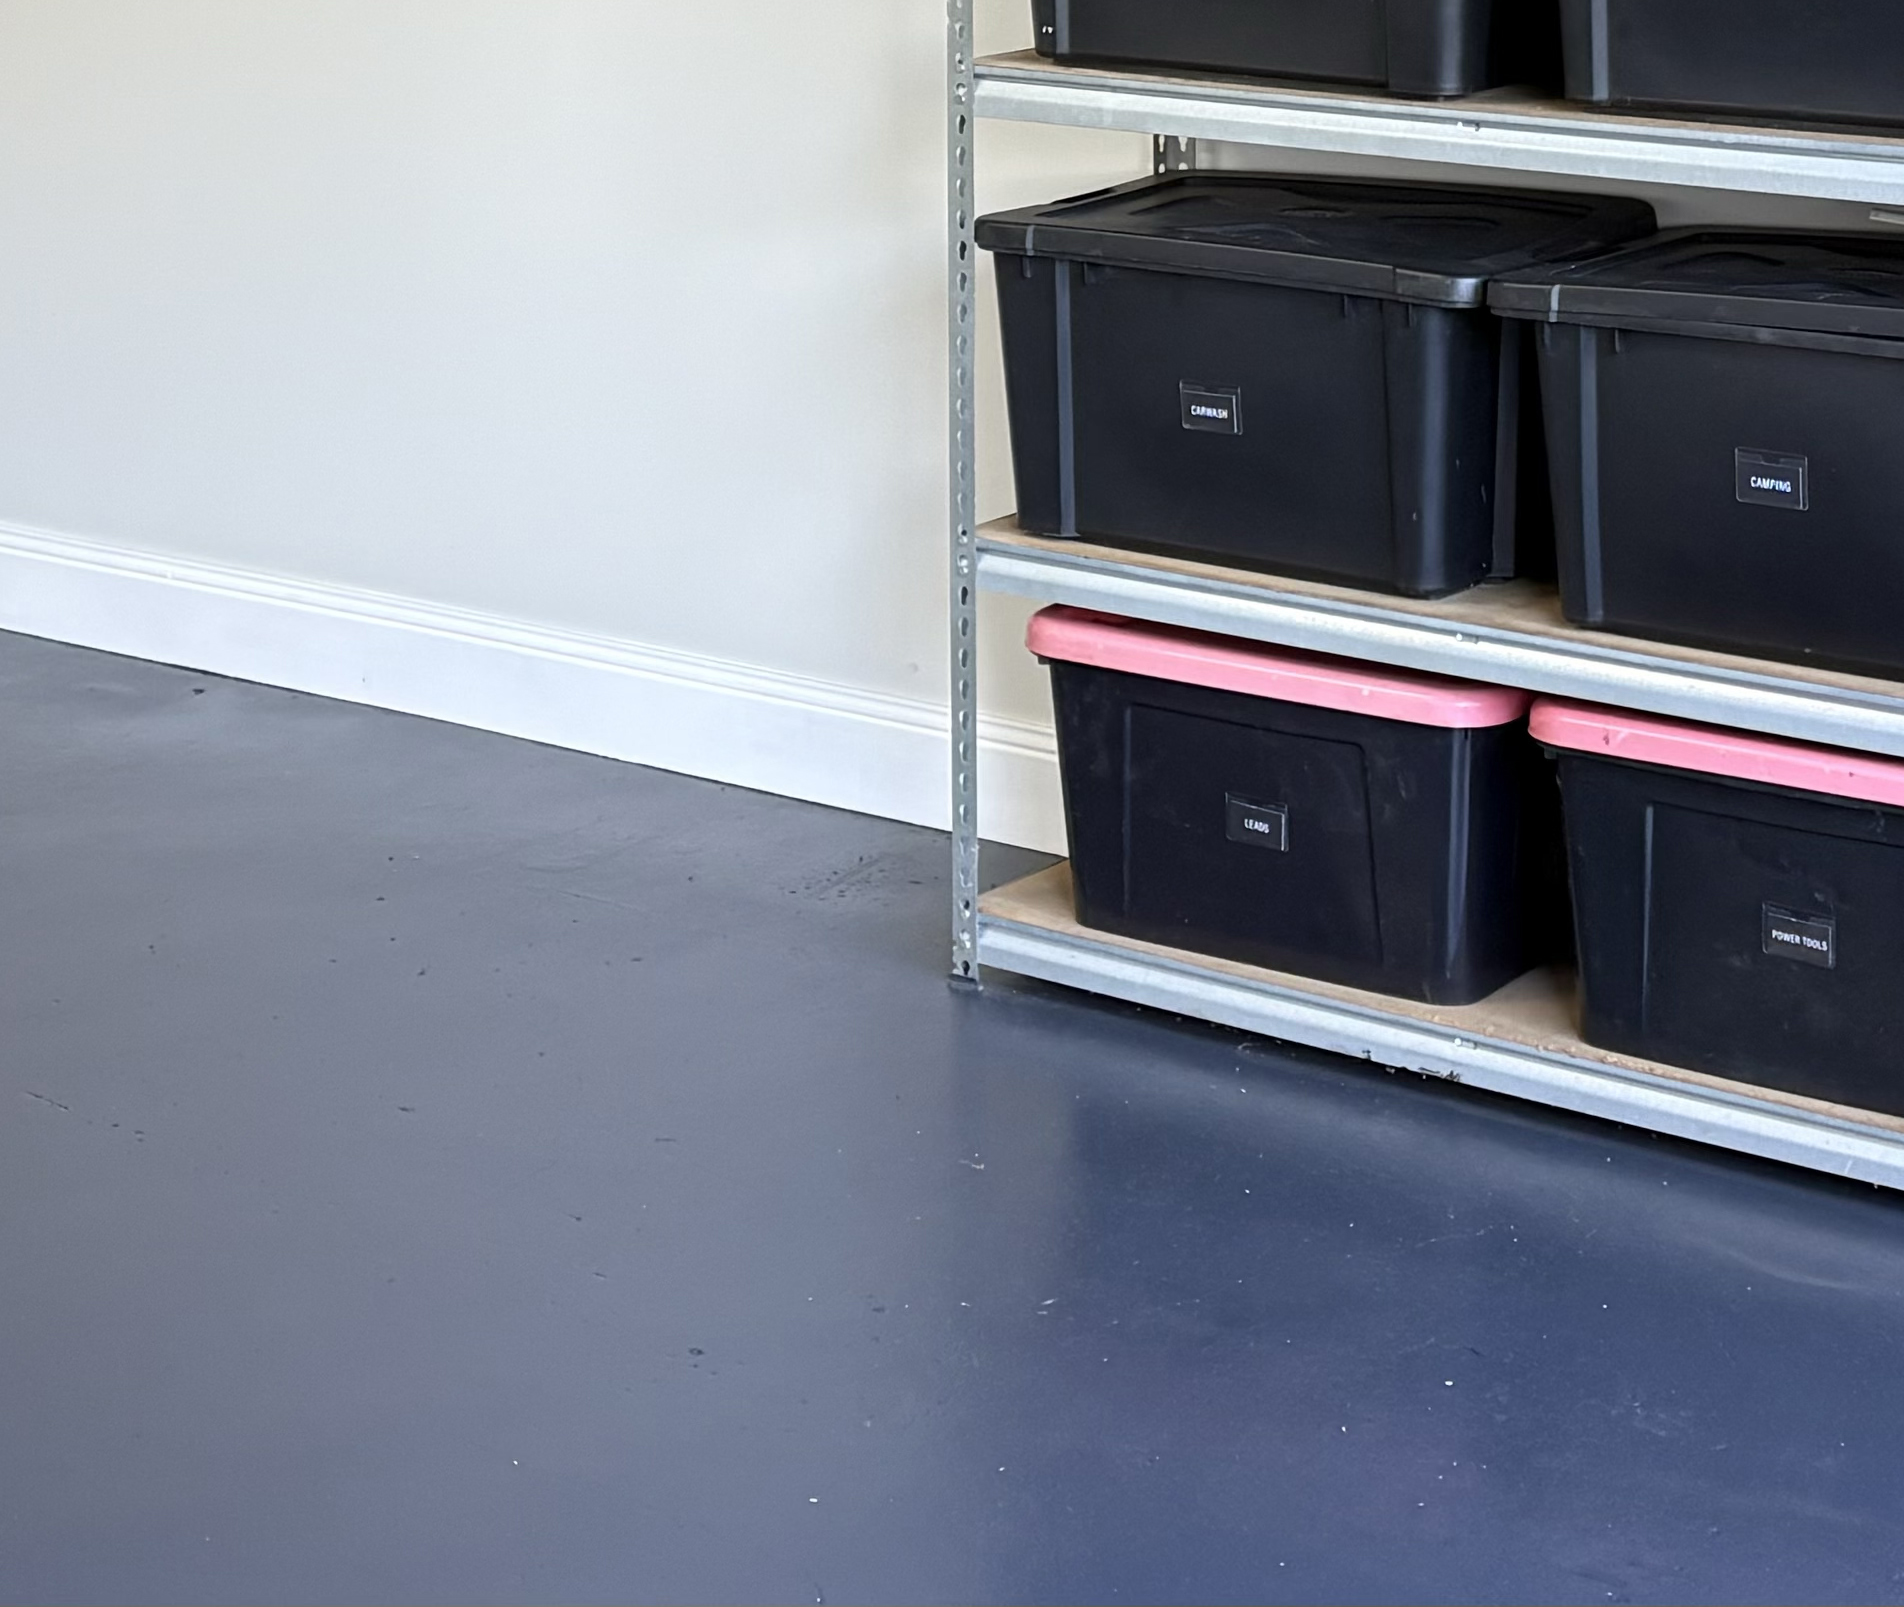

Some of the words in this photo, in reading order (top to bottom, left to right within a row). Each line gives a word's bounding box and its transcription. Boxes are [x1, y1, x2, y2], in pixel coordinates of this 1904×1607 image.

[1751, 477, 1792, 493] CAMPING
[1244, 818, 1270, 834] LEADS
[1772, 930, 1800, 945] POWER
[1802, 937, 1827, 952] TOOLS
